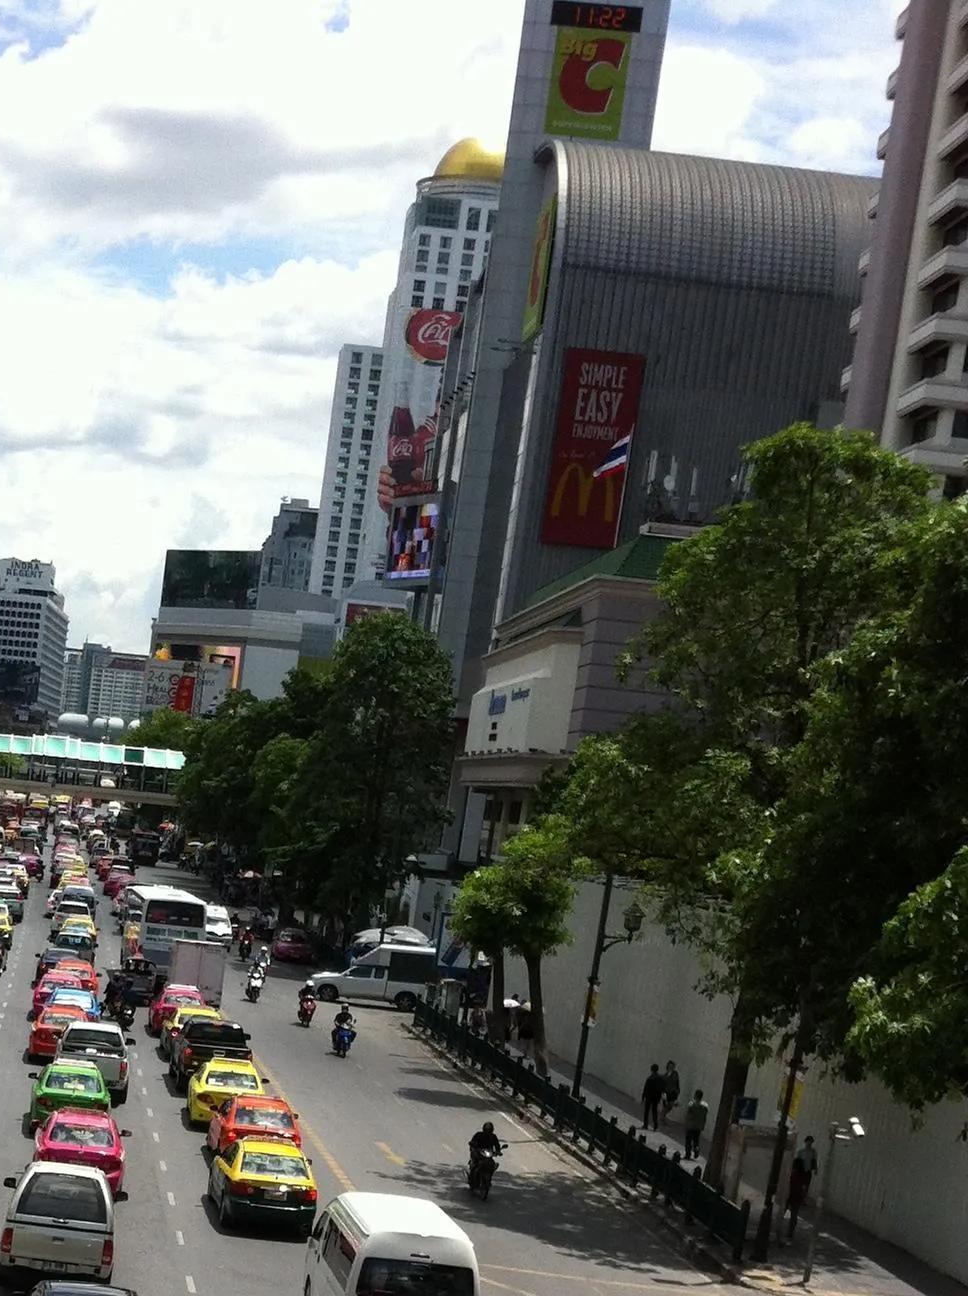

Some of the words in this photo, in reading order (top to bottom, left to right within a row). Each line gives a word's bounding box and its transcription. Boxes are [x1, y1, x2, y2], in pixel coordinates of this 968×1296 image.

[562, 38, 598, 61] Big
[559, 38, 627, 116] C
[579, 362, 628, 389] SIMPLE
[574, 388, 624, 423] EASY
[572, 423, 619, 441] ENJOYMENT
[6, 568, 43, 579] REGENT
[10, 560, 40, 571] INDRA
